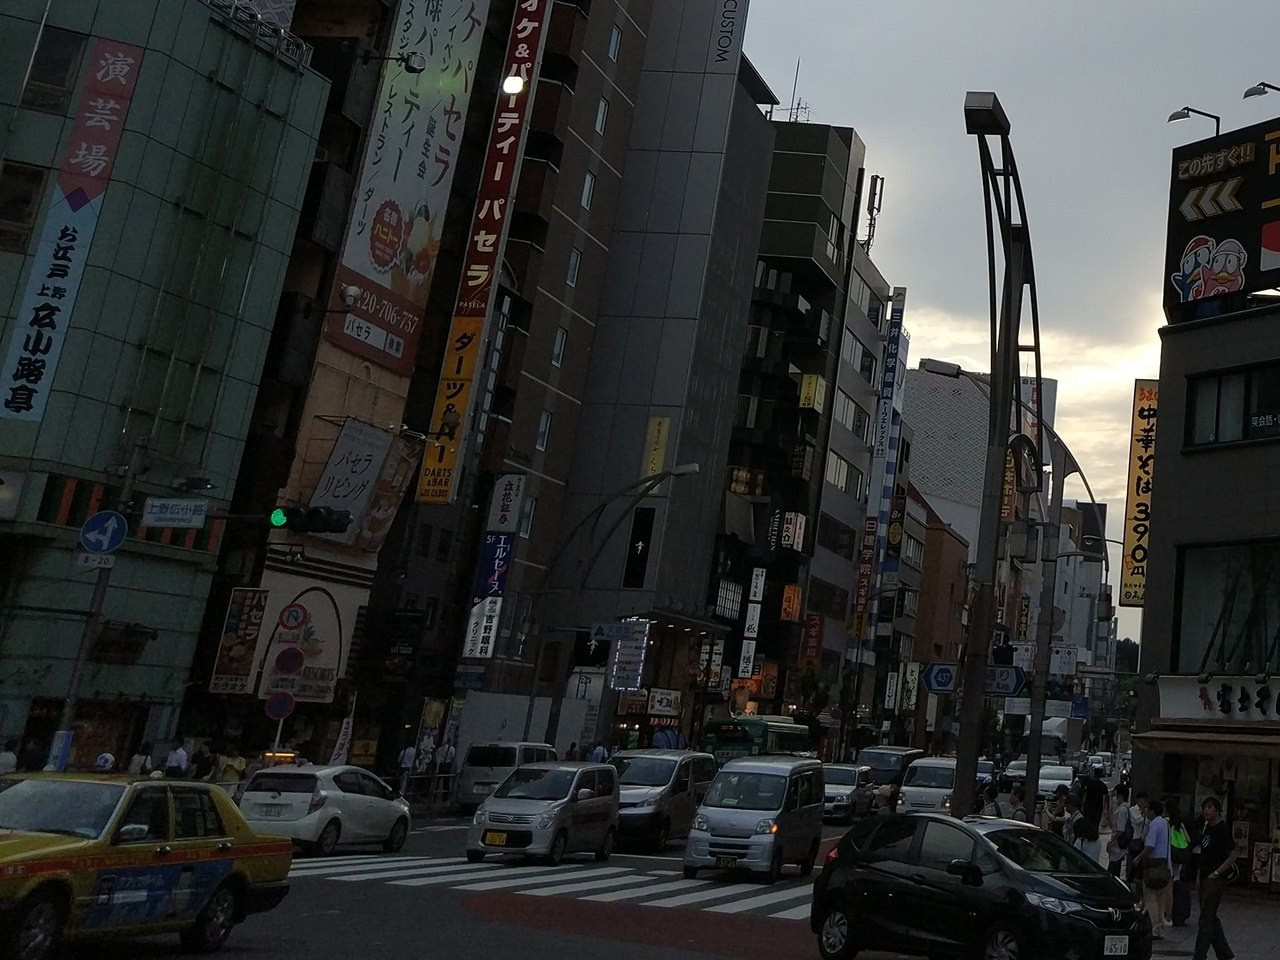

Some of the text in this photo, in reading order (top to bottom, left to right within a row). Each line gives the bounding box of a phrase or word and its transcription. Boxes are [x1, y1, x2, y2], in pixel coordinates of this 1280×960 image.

[70, 53, 135, 178] 演芸場
[467, 197, 507, 287] パセラ
[346, 318, 371, 340] パセラ
[1135, 404, 1158, 496] 中華そば
[334, 453, 374, 475] パセラ
[424, 467, 453, 480] DARTS
[322, 477, 370, 501] リビング
[147, 501, 205, 517] 上野広小路
